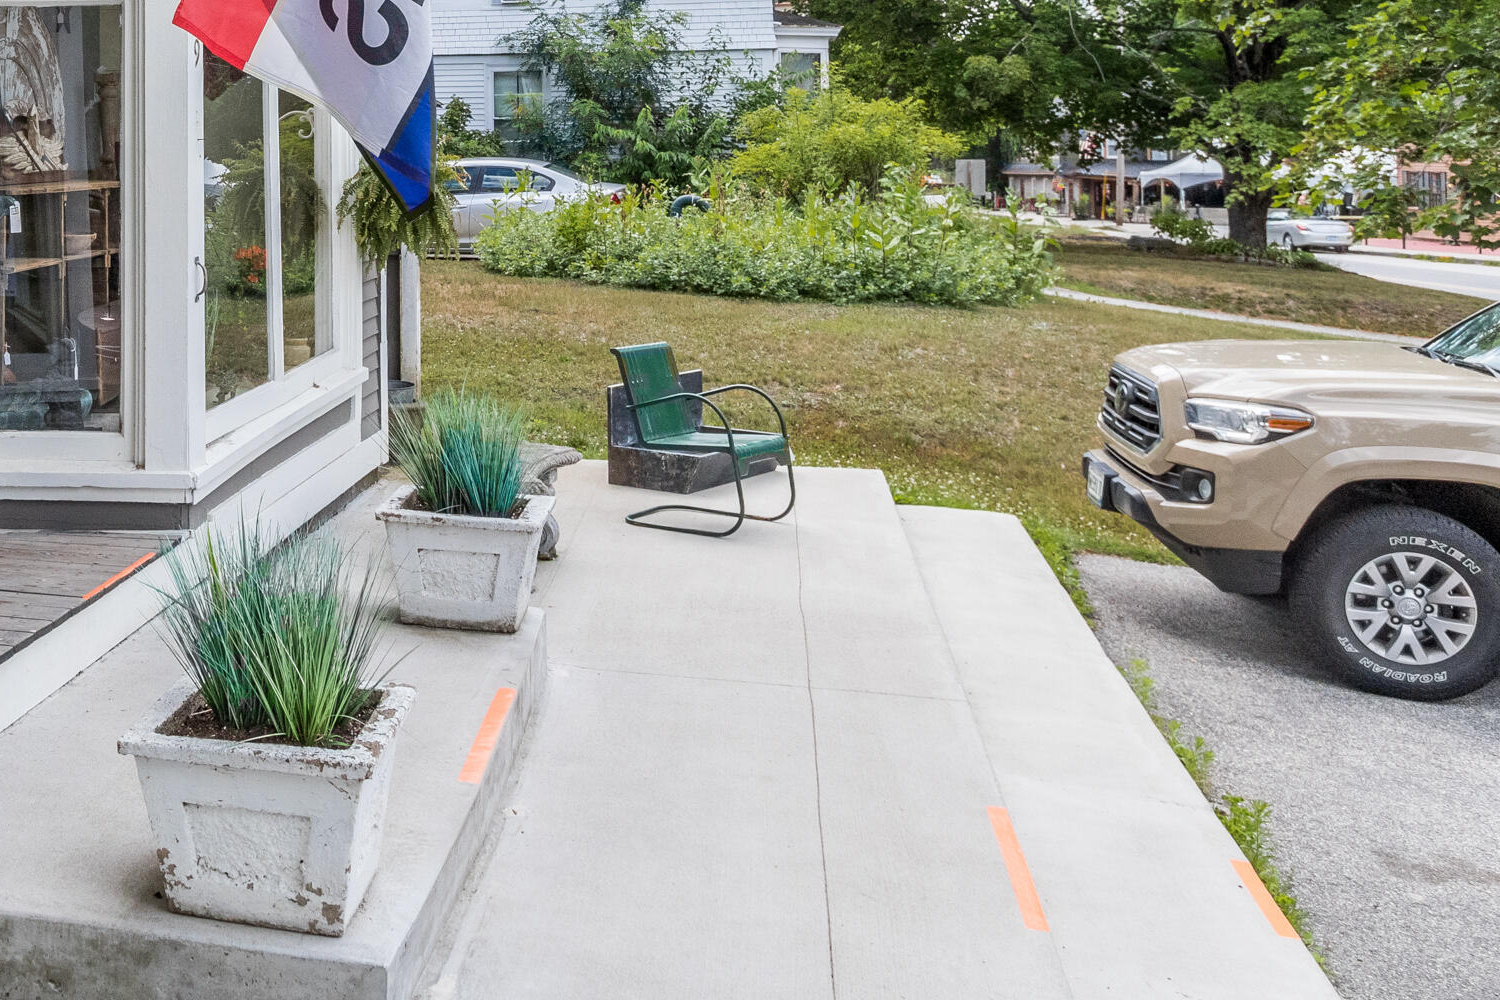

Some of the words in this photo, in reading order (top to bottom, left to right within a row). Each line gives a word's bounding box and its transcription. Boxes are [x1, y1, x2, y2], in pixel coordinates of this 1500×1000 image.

[1389, 536, 1482, 575] NEXEN
[1337, 635, 1360, 653] AT
[1359, 656, 1448, 684] ROADIAN
